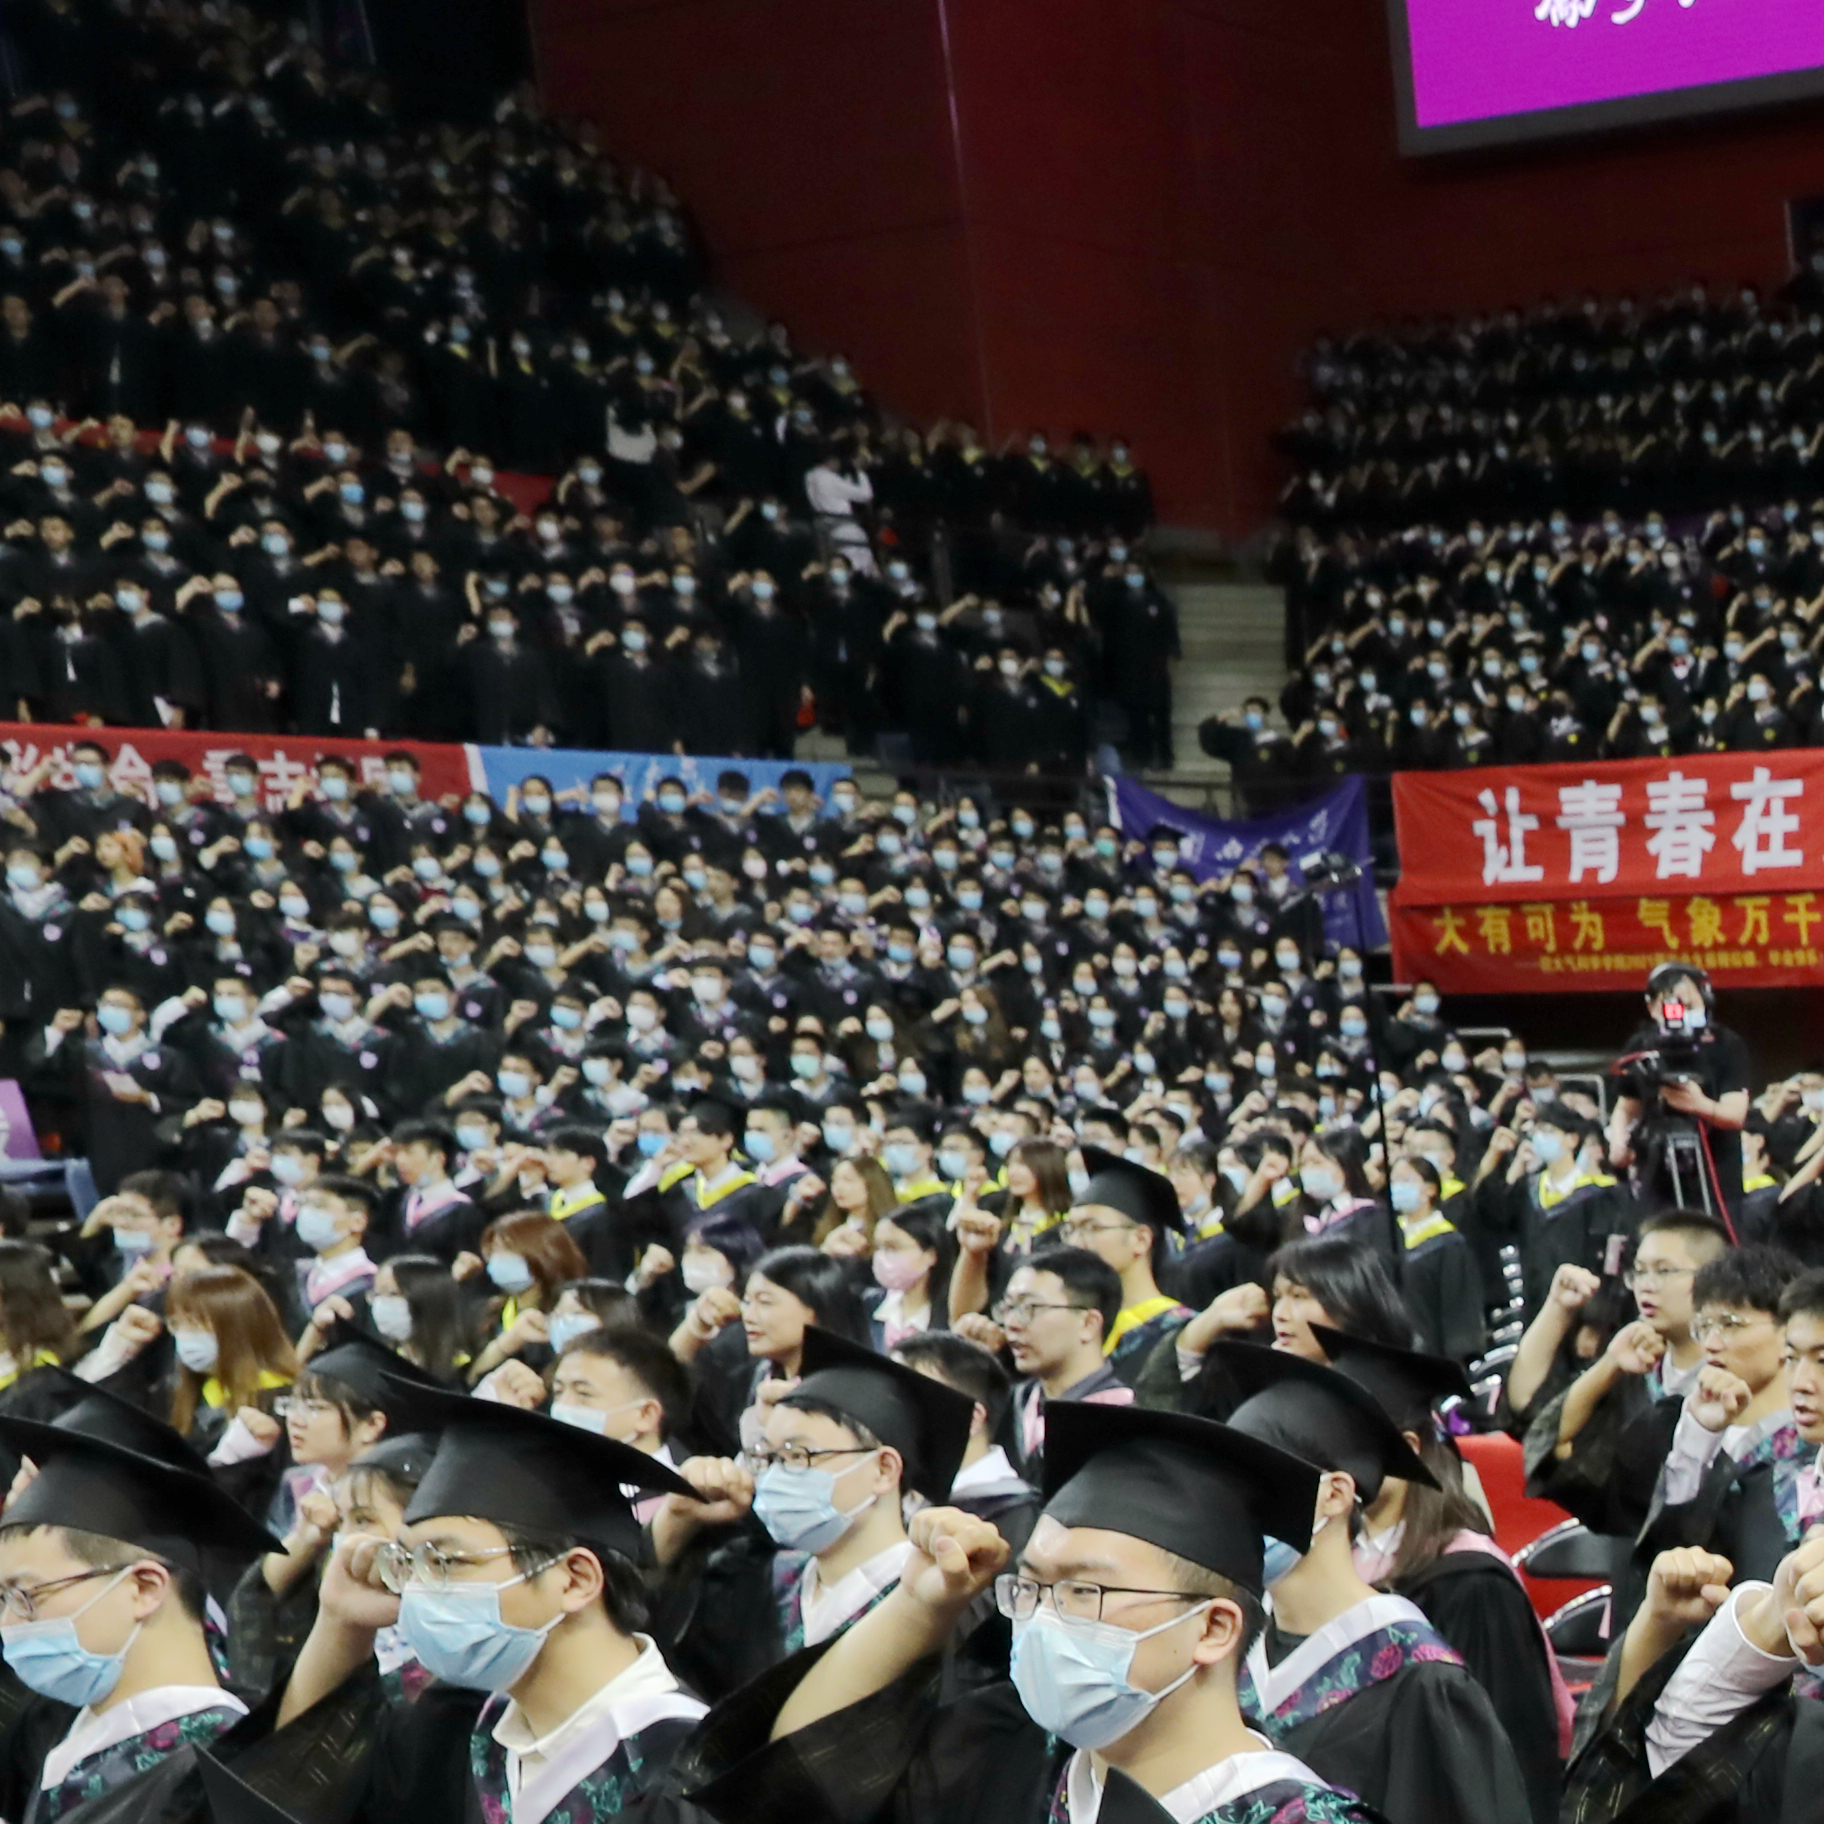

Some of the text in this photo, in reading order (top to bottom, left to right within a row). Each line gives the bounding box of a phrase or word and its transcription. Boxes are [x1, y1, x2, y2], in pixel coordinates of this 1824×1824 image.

[1433, 893, 1821, 954] 大有可为 气象万千
